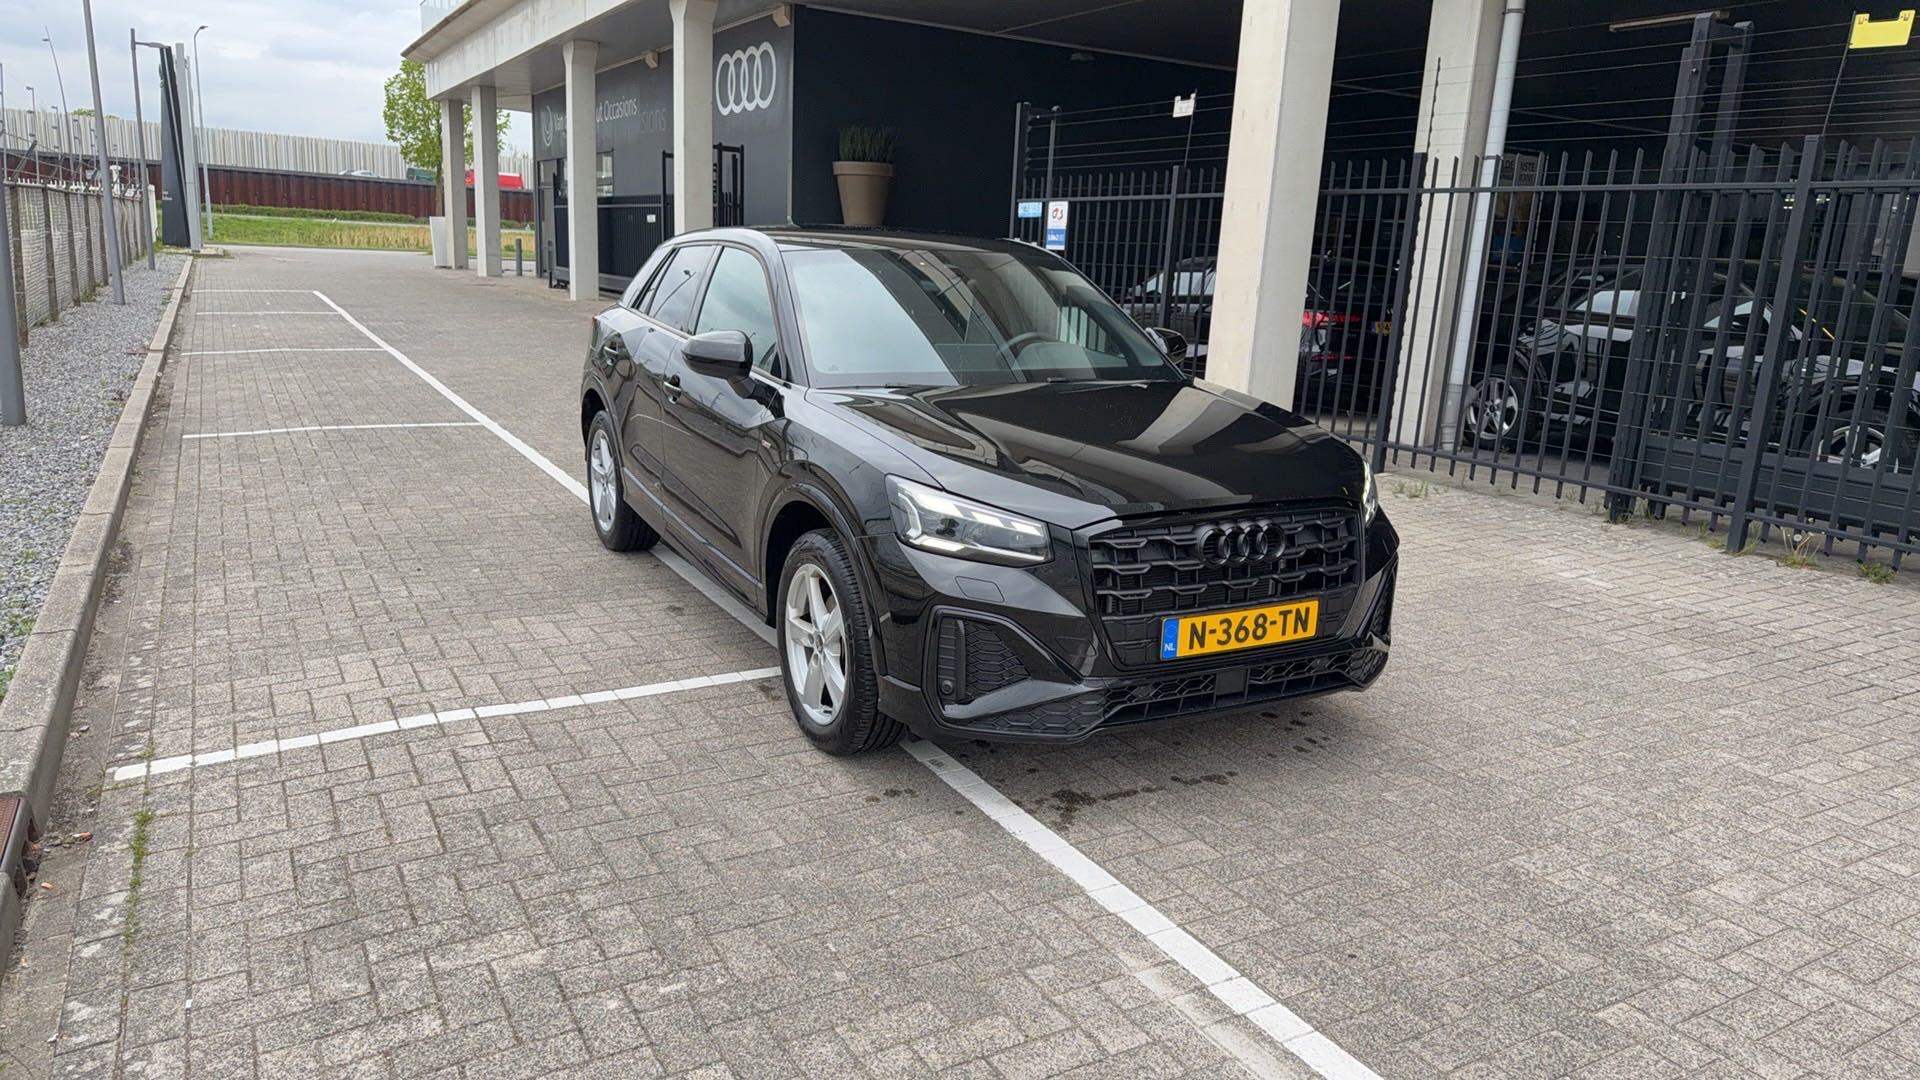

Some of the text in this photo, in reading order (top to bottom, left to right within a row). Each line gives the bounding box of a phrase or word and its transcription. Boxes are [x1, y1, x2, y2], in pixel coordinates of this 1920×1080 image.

[604, 97, 638, 121] Occasions
[1188, 606, 1310, 650] N-368-TN
[1164, 642, 1176, 652] NL
